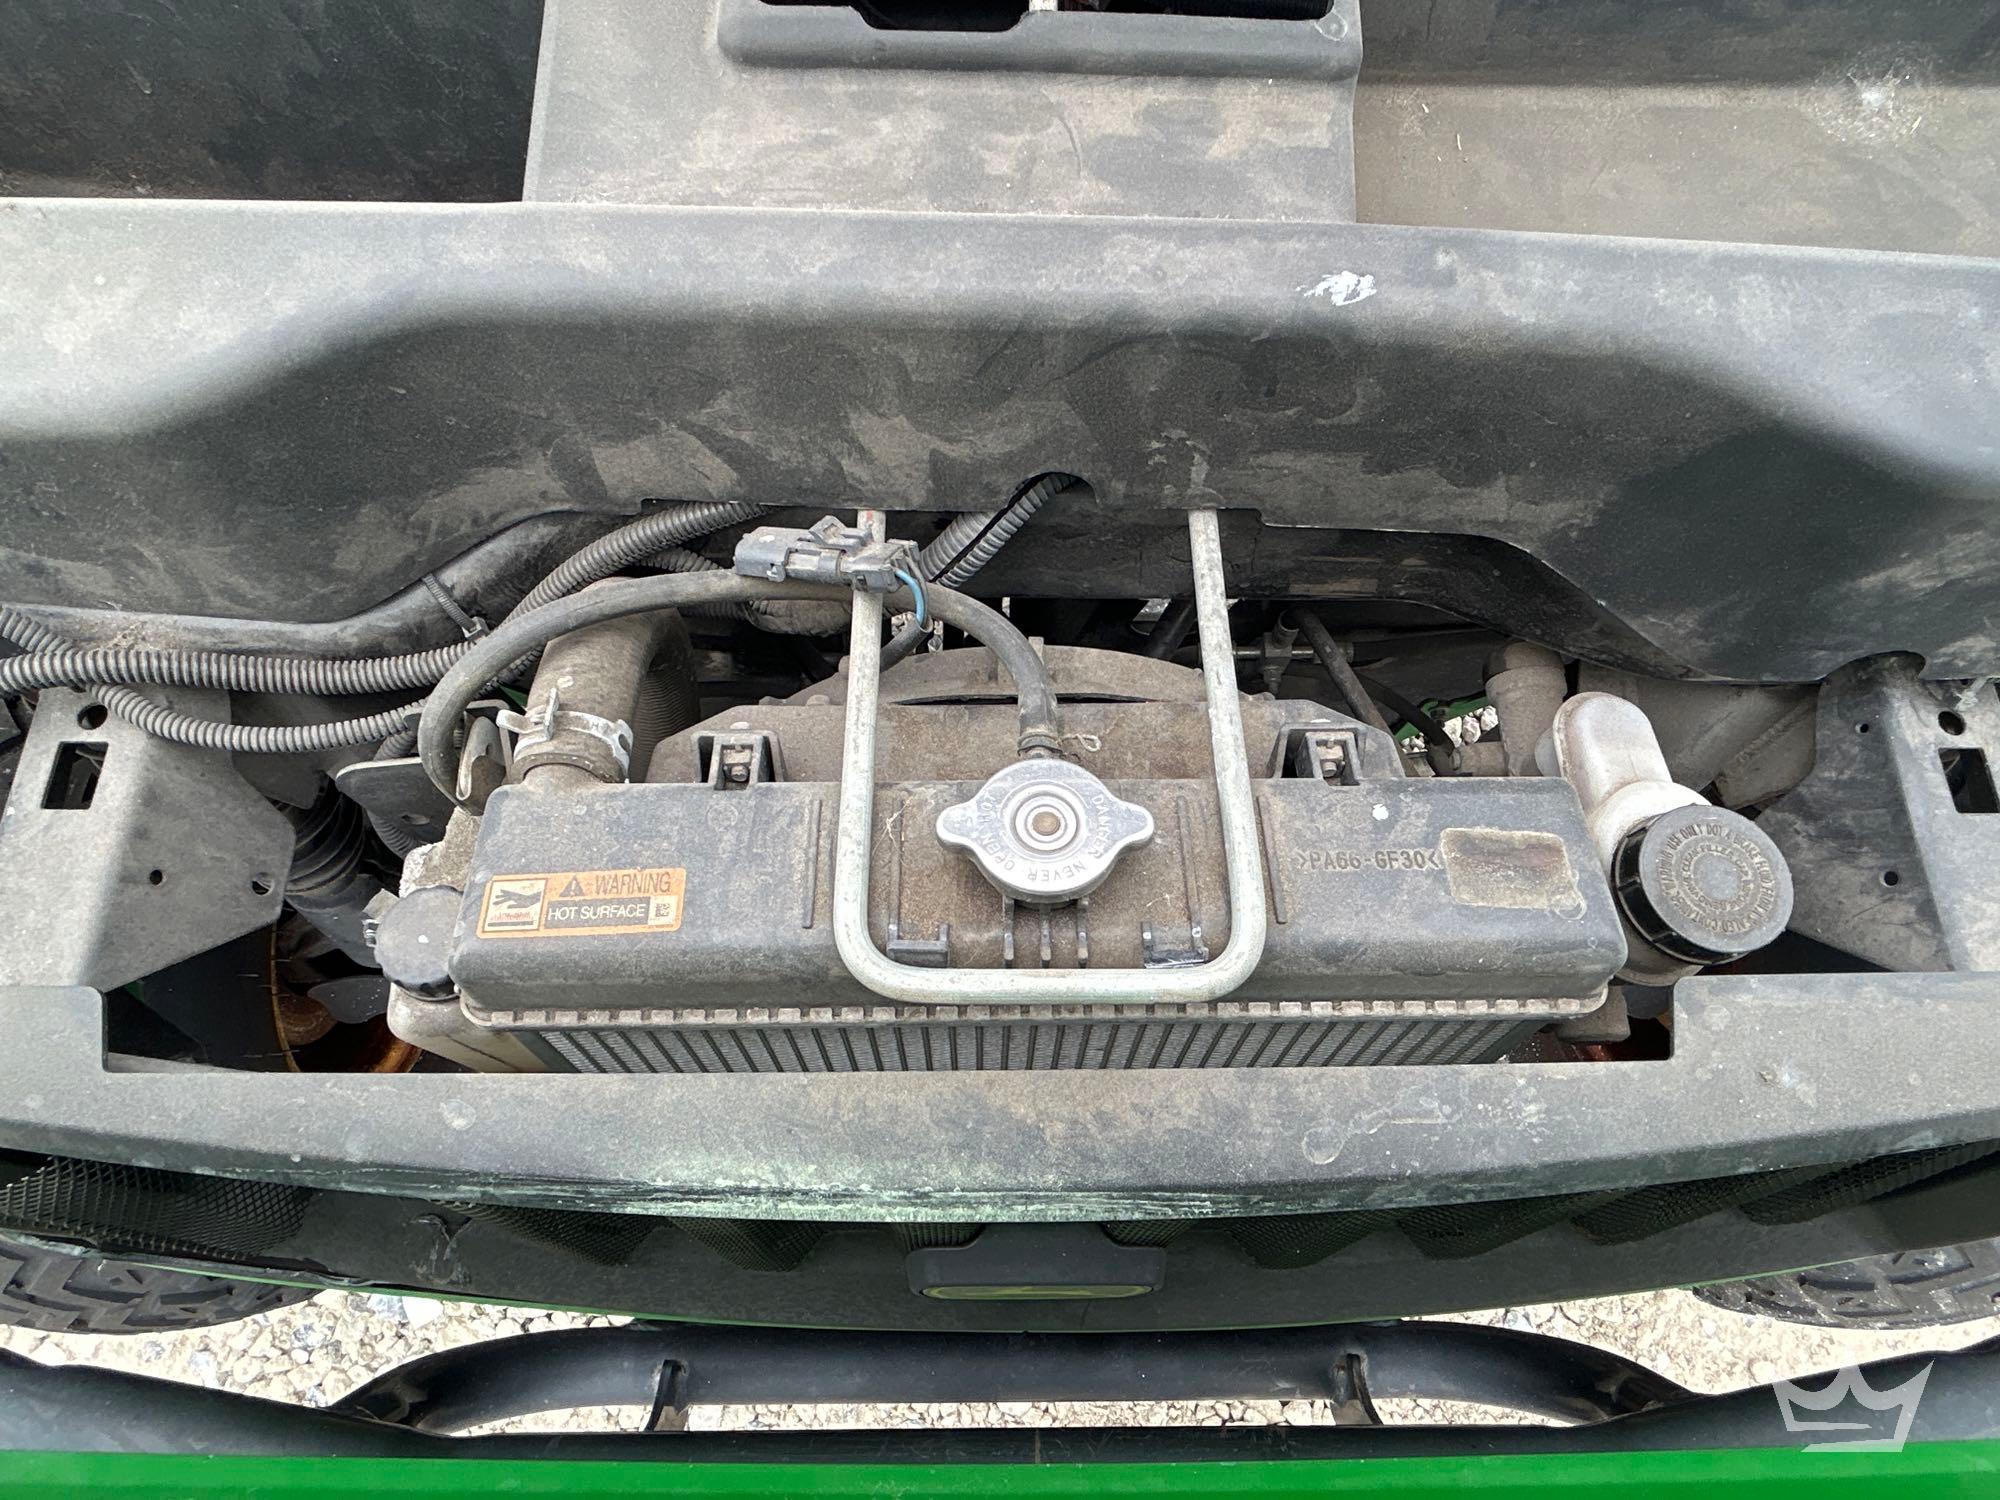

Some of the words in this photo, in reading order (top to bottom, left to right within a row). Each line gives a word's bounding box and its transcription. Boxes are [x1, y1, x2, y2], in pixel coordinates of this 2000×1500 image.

[978, 791, 997, 824] HOT
[1089, 794, 1112, 859] DANGER
[1666, 832, 1682, 850] USE
[1679, 823, 1703, 840] ONLY
[980, 830, 1015, 872] OPEN
[1699, 843, 1734, 860] FILLER
[594, 872, 672, 895] WARNING
[1028, 860, 1087, 882] NEVER
[548, 905, 578, 921] HOT
[580, 903, 647, 921] SURFACE
